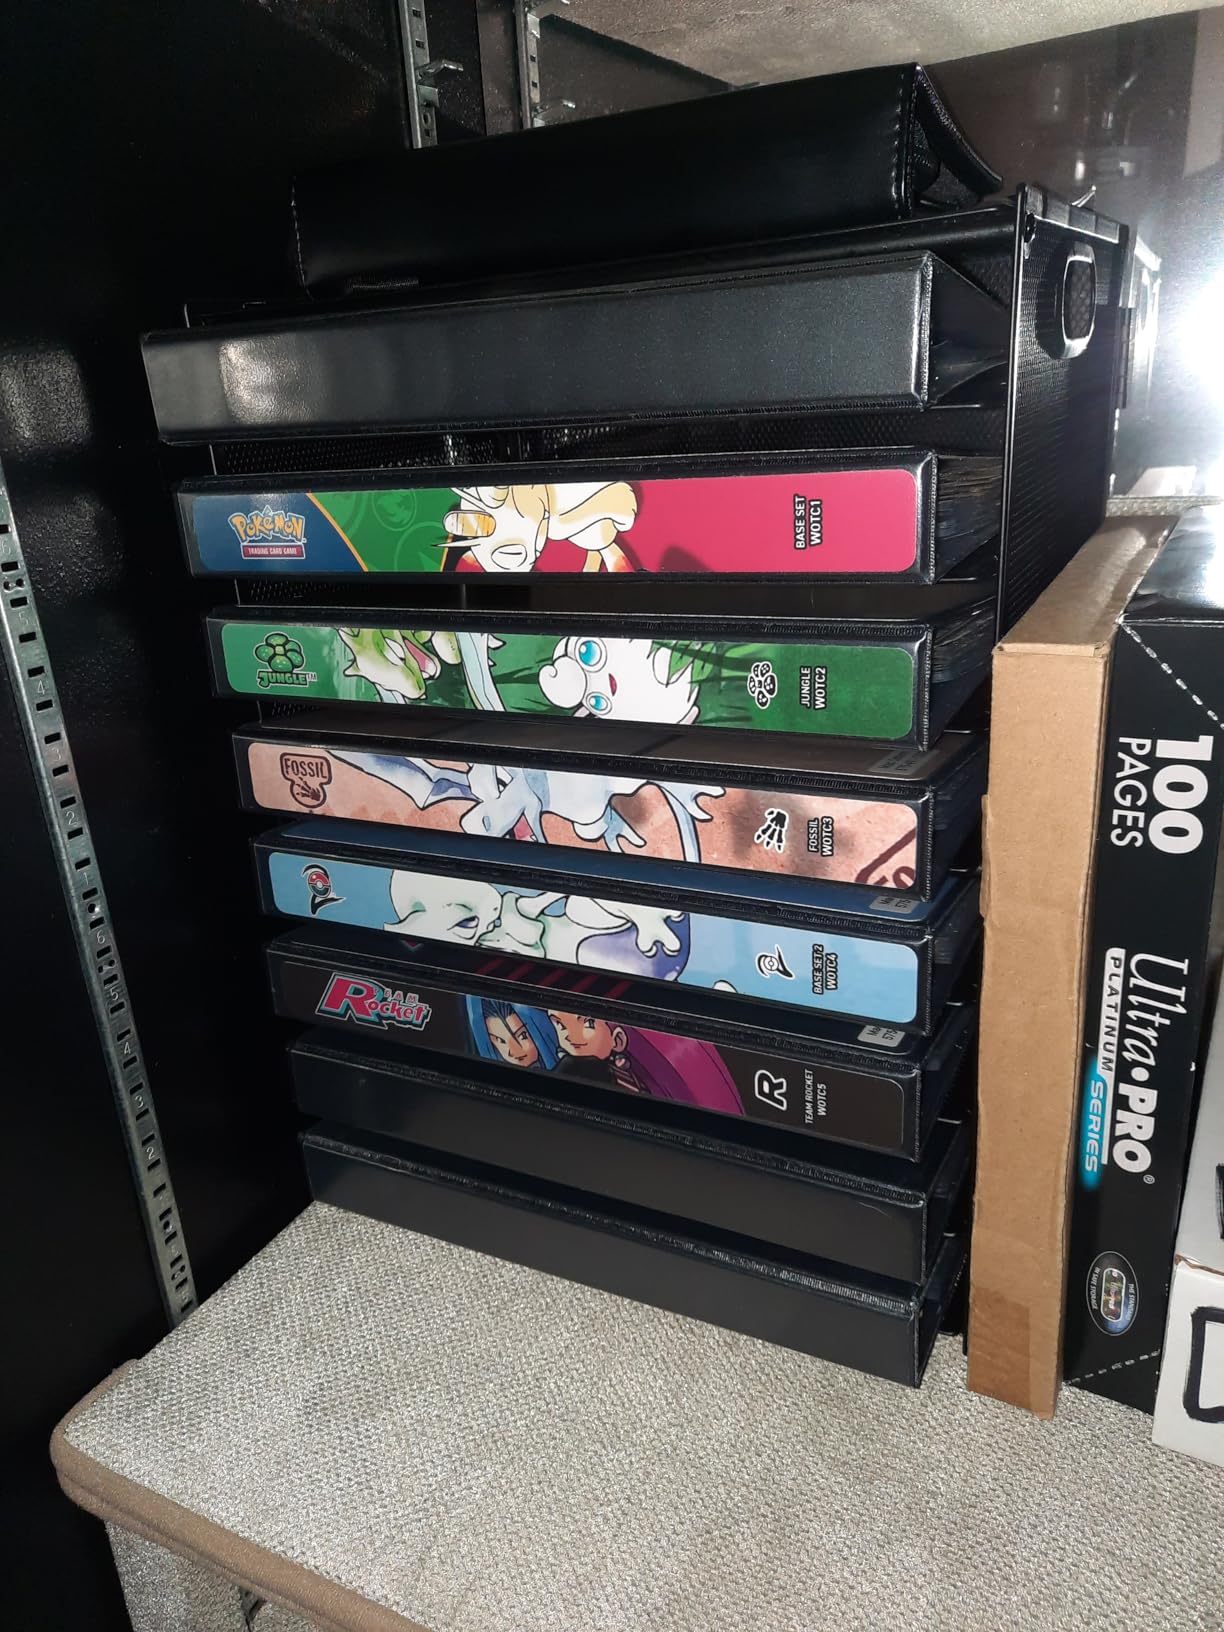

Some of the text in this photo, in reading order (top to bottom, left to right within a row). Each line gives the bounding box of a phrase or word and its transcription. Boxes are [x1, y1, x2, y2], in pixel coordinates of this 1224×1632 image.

[794, 495, 806, 549] BASE SET
[810, 500, 822, 545] WOTC1
[248, 547, 297, 555] TRADING CARD GAME
[257, 670, 308, 688] JUNGLE
[800, 667, 811, 708] JUNGLE
[814, 667, 826, 709] WOTC2
[284, 757, 328, 779] FOSSIL
[1110, 737, 1152, 847] PAGES
[1148, 735, 1214, 854] 100
[808, 819, 819, 852] FOSSIL
[821, 817, 833, 857] WOTC3
[813, 951, 824, 969] SET
[826, 953, 838, 990] WOTC4
[320, 976, 426, 1024] Rocket
[813, 969, 823, 994] BASE
[1100, 956, 1122, 1073] PLATINUM
[804, 1068, 814, 1124] TEAM ROCKET
[817, 1083, 827, 1116] WOTC5
[1084, 1080, 1104, 1173] SERIES
[1127, 1283, 1136, 1293] THE
